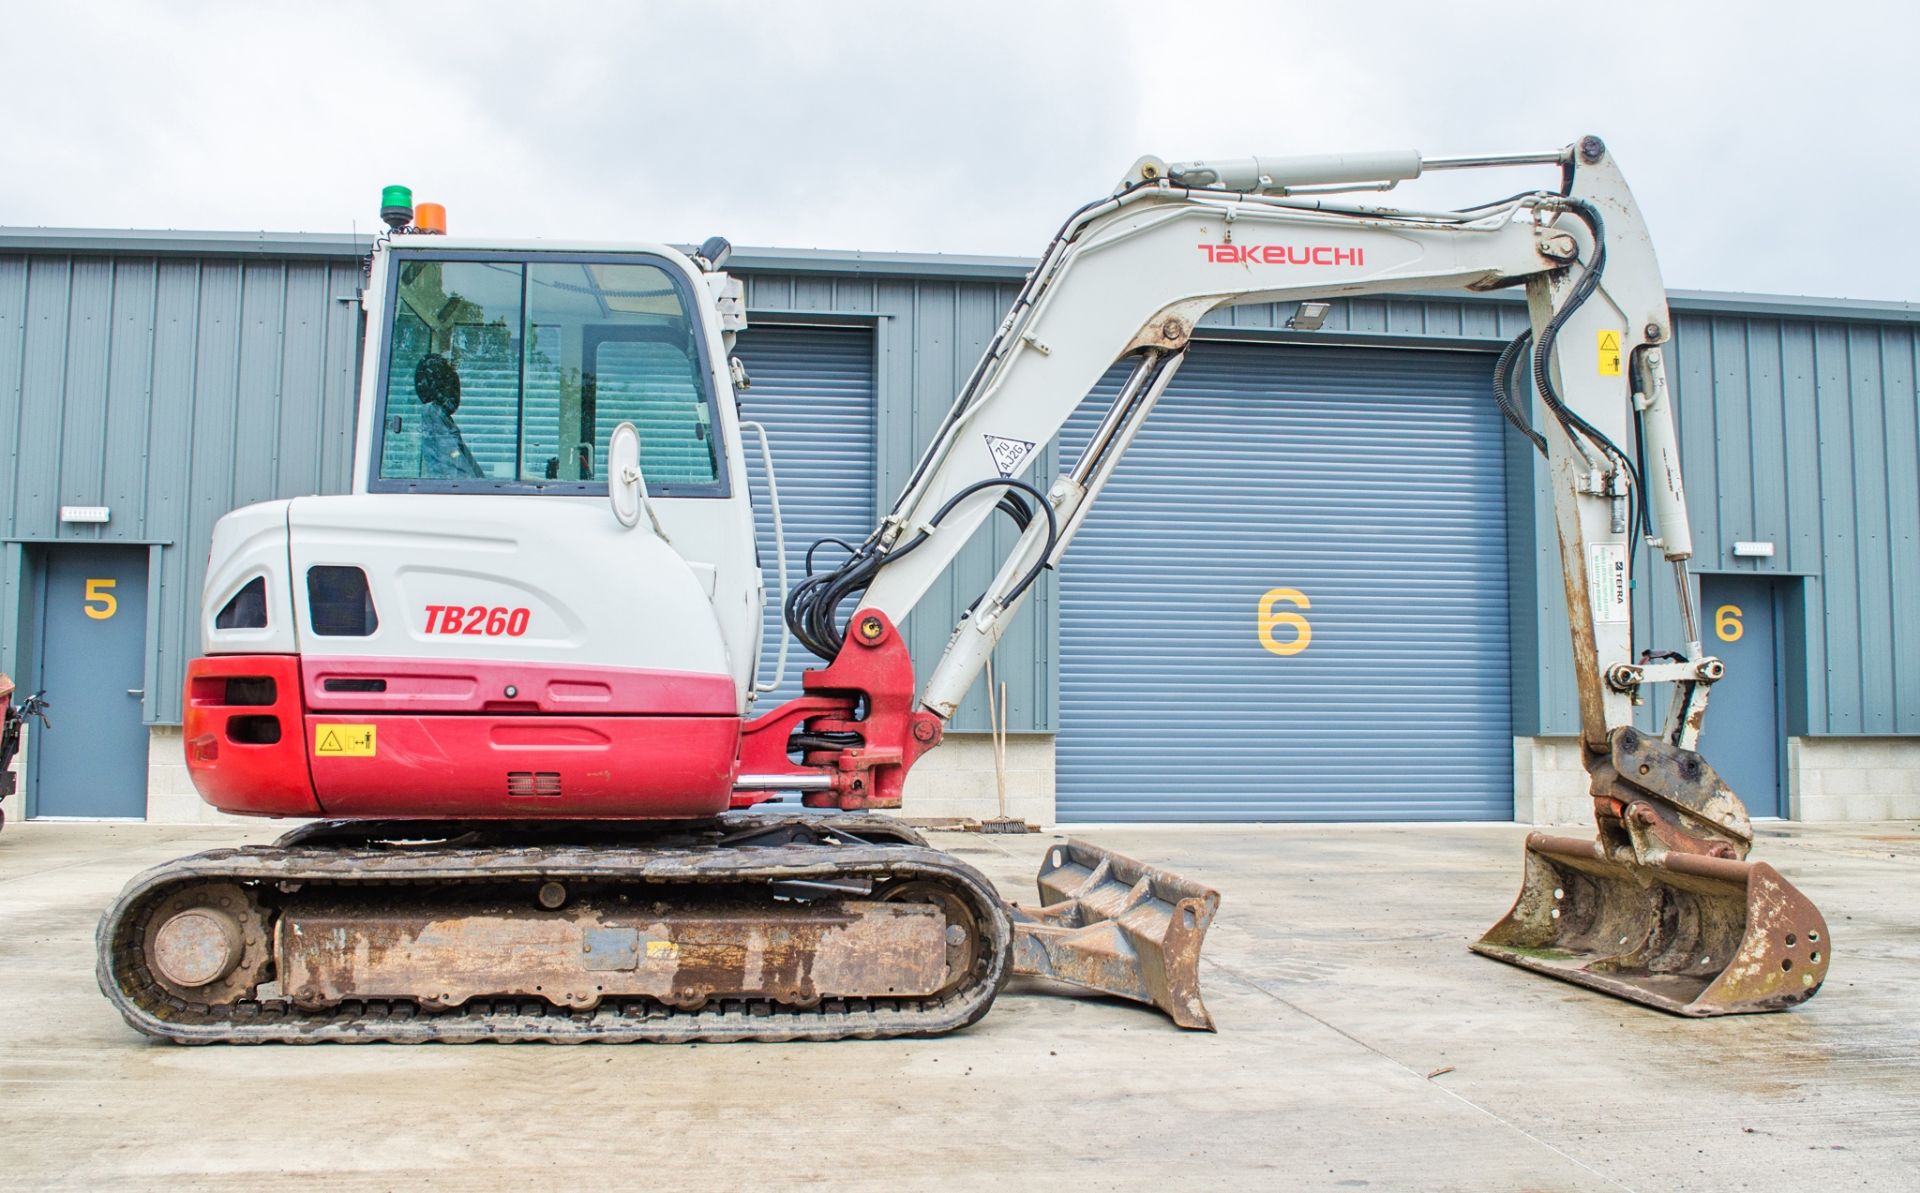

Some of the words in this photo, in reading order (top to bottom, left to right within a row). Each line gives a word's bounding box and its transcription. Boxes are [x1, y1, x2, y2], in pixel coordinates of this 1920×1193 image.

[1000, 444, 1024, 471] AJ2G
[84, 578, 117, 620] 5
[1616, 573, 1624, 604] TEFRA
[425, 605, 531, 637] TB260
[1257, 588, 1312, 656] 6
[1715, 604, 1743, 641] 6
